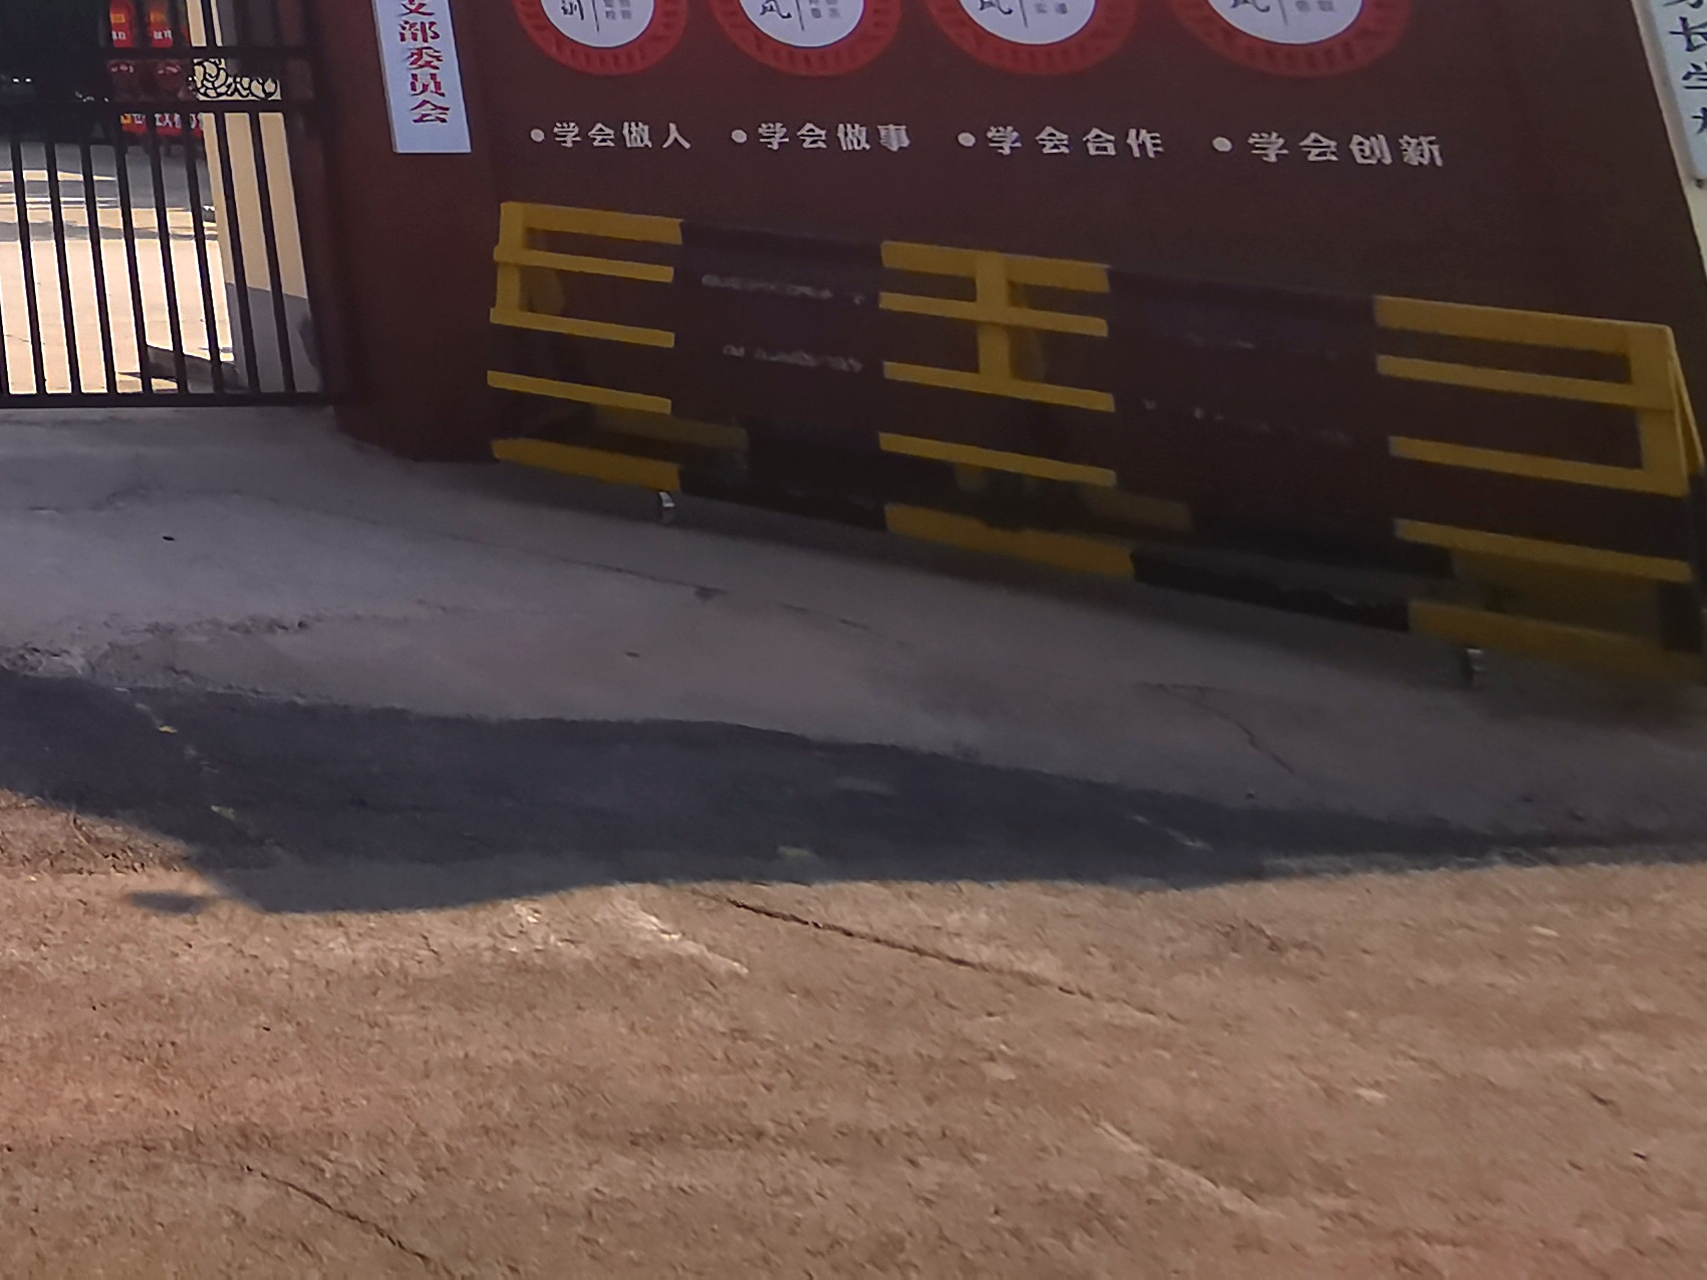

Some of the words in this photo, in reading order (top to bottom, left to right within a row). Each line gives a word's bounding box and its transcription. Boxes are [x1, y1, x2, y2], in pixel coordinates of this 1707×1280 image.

[553, 121, 691, 150] 学会做人
[757, 121, 911, 152] 学会做事
[986, 125, 1164, 158] 学会合作
[1248, 130, 1444, 168] 学会创新
